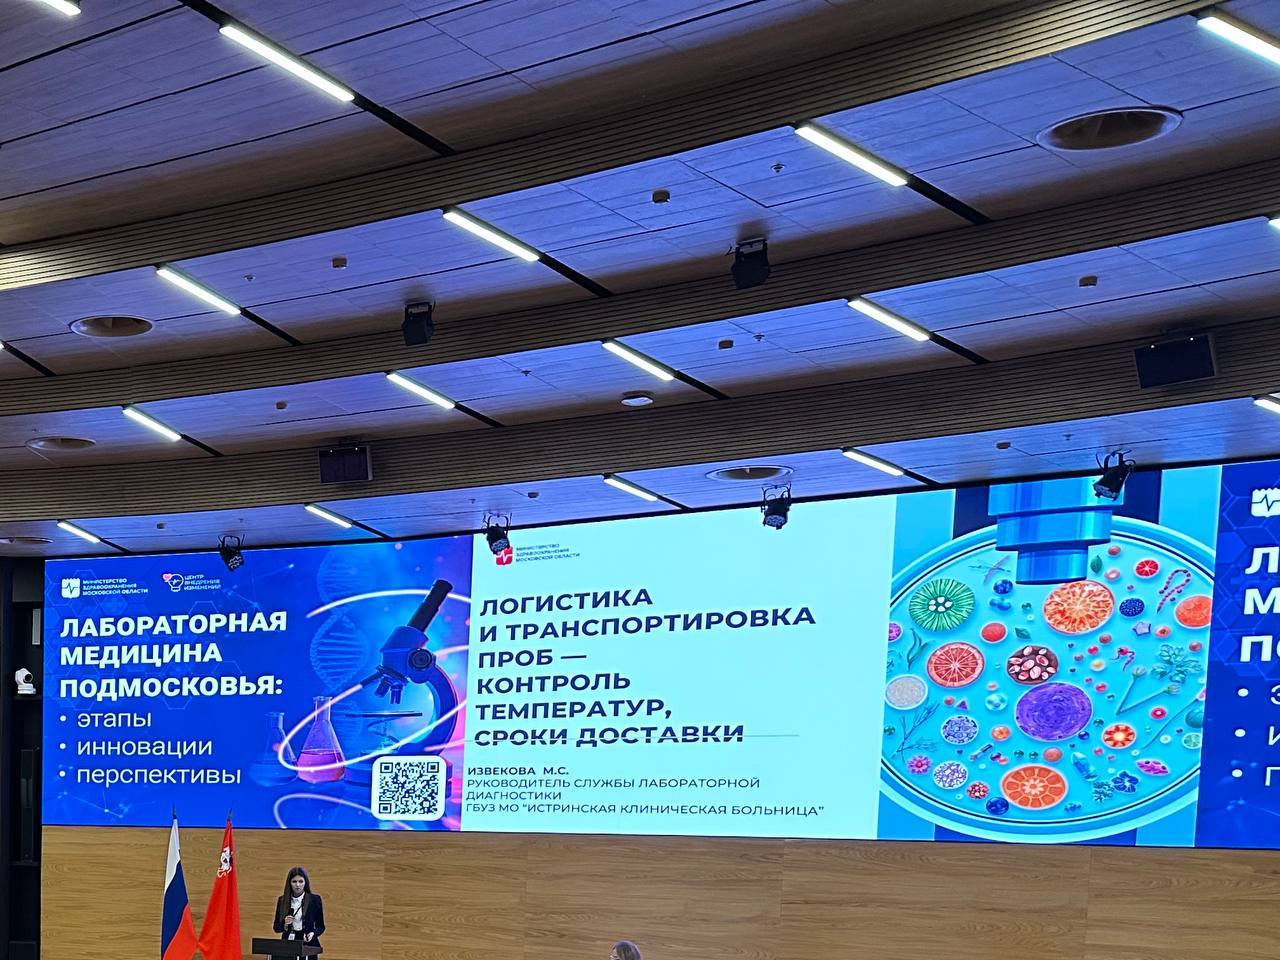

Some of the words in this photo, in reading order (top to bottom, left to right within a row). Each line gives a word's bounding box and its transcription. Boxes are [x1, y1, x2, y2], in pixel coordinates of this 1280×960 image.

[479, 588, 653, 616] ЛОГИСТИКА
[60, 611, 288, 637] ЛАБОРАТОРНАЯ
[480, 625, 497, 642] И
[506, 606, 817, 641] ТРАНСПОРТИРОВКА
[60, 642, 223, 669] МЕДИЦИНА
[478, 649, 553, 669] ПРОБ
[59, 675, 283, 701] ПОДМОСКОВЬЯ:
[477, 672, 631, 695] КОНТРОЛЬ
[475, 699, 672, 720] ТЕМПЕРАТУР,
[77, 712, 151, 728] этапы
[474, 728, 568, 746] СРОКИ
[576, 725, 744, 748] ДОСТАВКИ
[77, 740, 213, 759] инновации
[77, 768, 241, 788] перспективы
[467, 767, 536, 776] ИЗВЕКОВА
[543, 766, 569, 775] М.С.
[467, 778, 570, 789] РУКОВОДИТЕЛЬ
[574, 778, 635, 788] СЛУЖБЫ
[638, 777, 760, 788] ЛАБОРАТОРНОЙ
[466, 791, 562, 801] ДИАГНОСТИКИ
[466, 803, 495, 812] ГБУЗ
[499, 803, 519, 813] МО
[620, 804, 727, 815] КЛИНИЧЕСКАЯ
